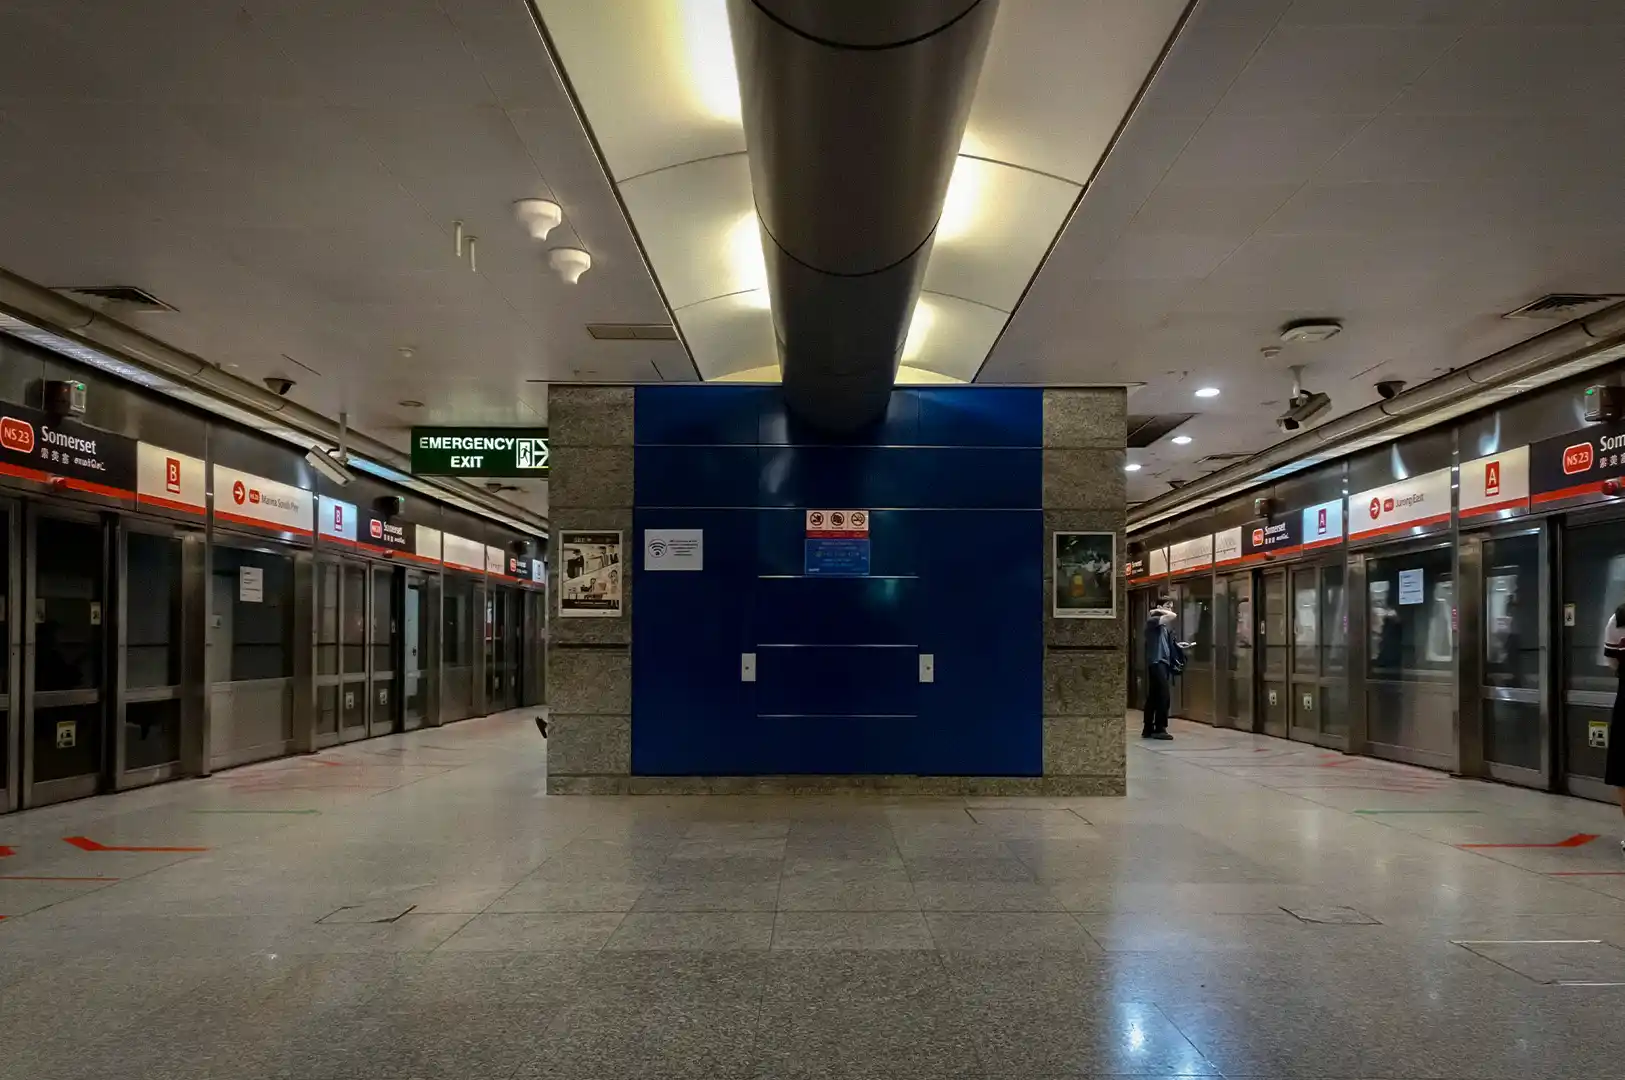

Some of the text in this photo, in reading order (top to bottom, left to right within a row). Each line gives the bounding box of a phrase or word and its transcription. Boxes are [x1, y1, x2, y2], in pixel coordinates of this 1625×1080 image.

[41, 426, 97, 455] Somerset
[419, 437, 515, 450] EMERGENCY
[450, 456, 484, 468] EXIT
[169, 464, 178, 482] B
[1488, 467, 1497, 486] A
